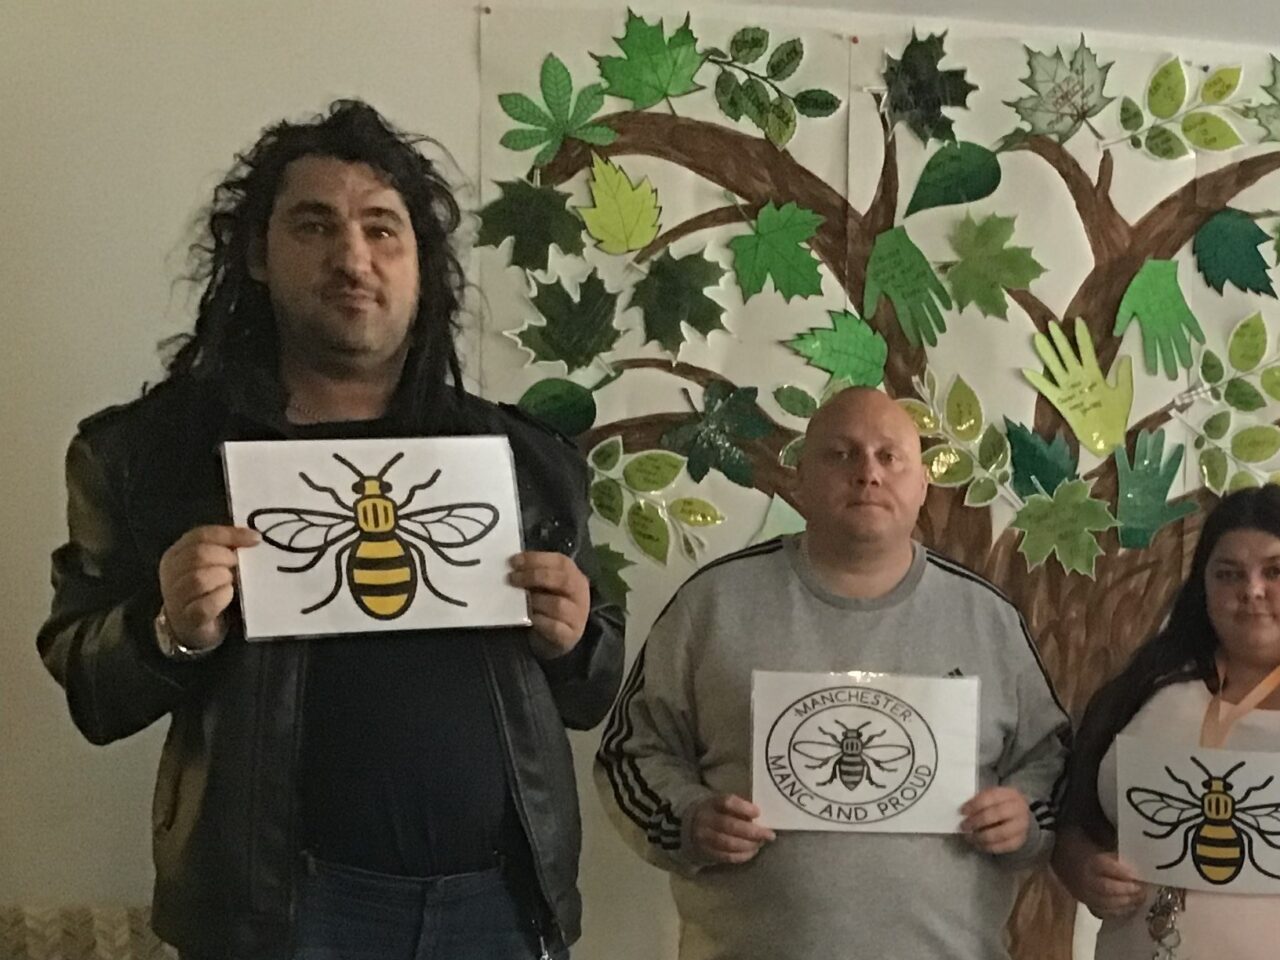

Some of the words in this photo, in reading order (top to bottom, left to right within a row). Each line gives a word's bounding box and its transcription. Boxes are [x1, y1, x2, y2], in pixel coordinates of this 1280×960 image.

[795, 690, 912, 721] MANCHESTER
[769, 754, 815, 808] MANC
[819, 803, 868, 821] AND
[877, 764, 932, 817] PROUD
